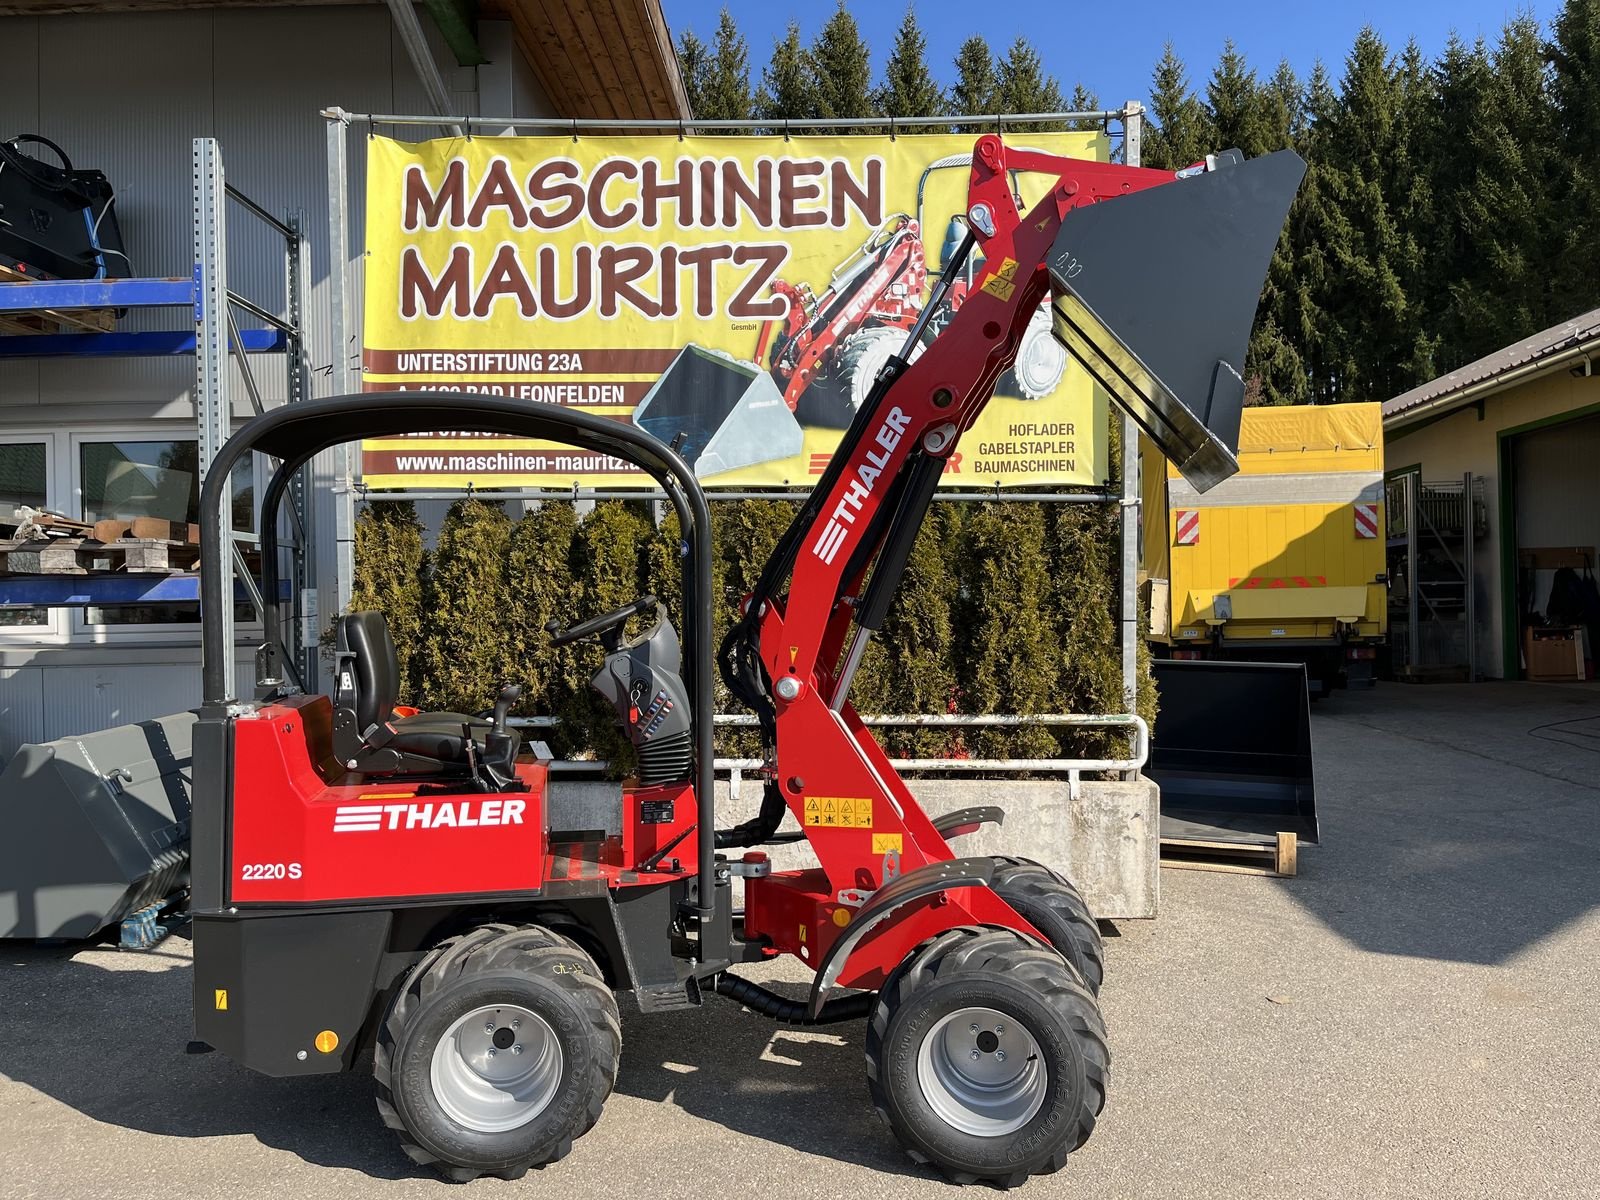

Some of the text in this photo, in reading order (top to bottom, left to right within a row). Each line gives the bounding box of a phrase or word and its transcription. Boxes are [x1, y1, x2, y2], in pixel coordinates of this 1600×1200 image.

[404, 158, 884, 231] MASCHINEN
[400, 243, 791, 318] MAURITZ
[731, 323, 757, 331] GesmbH
[397, 353, 583, 372] UNTERSTIFTUNG 23A
[1008, 423, 1075, 437] HOFLADER
[979, 441, 1075, 456] GABELSTAPLER
[832, 406, 912, 524] THALER
[974, 459, 1075, 474] BAUMASCHINEN
[383, 799, 527, 830] THALER
[241, 862, 303, 880] 2220 S
